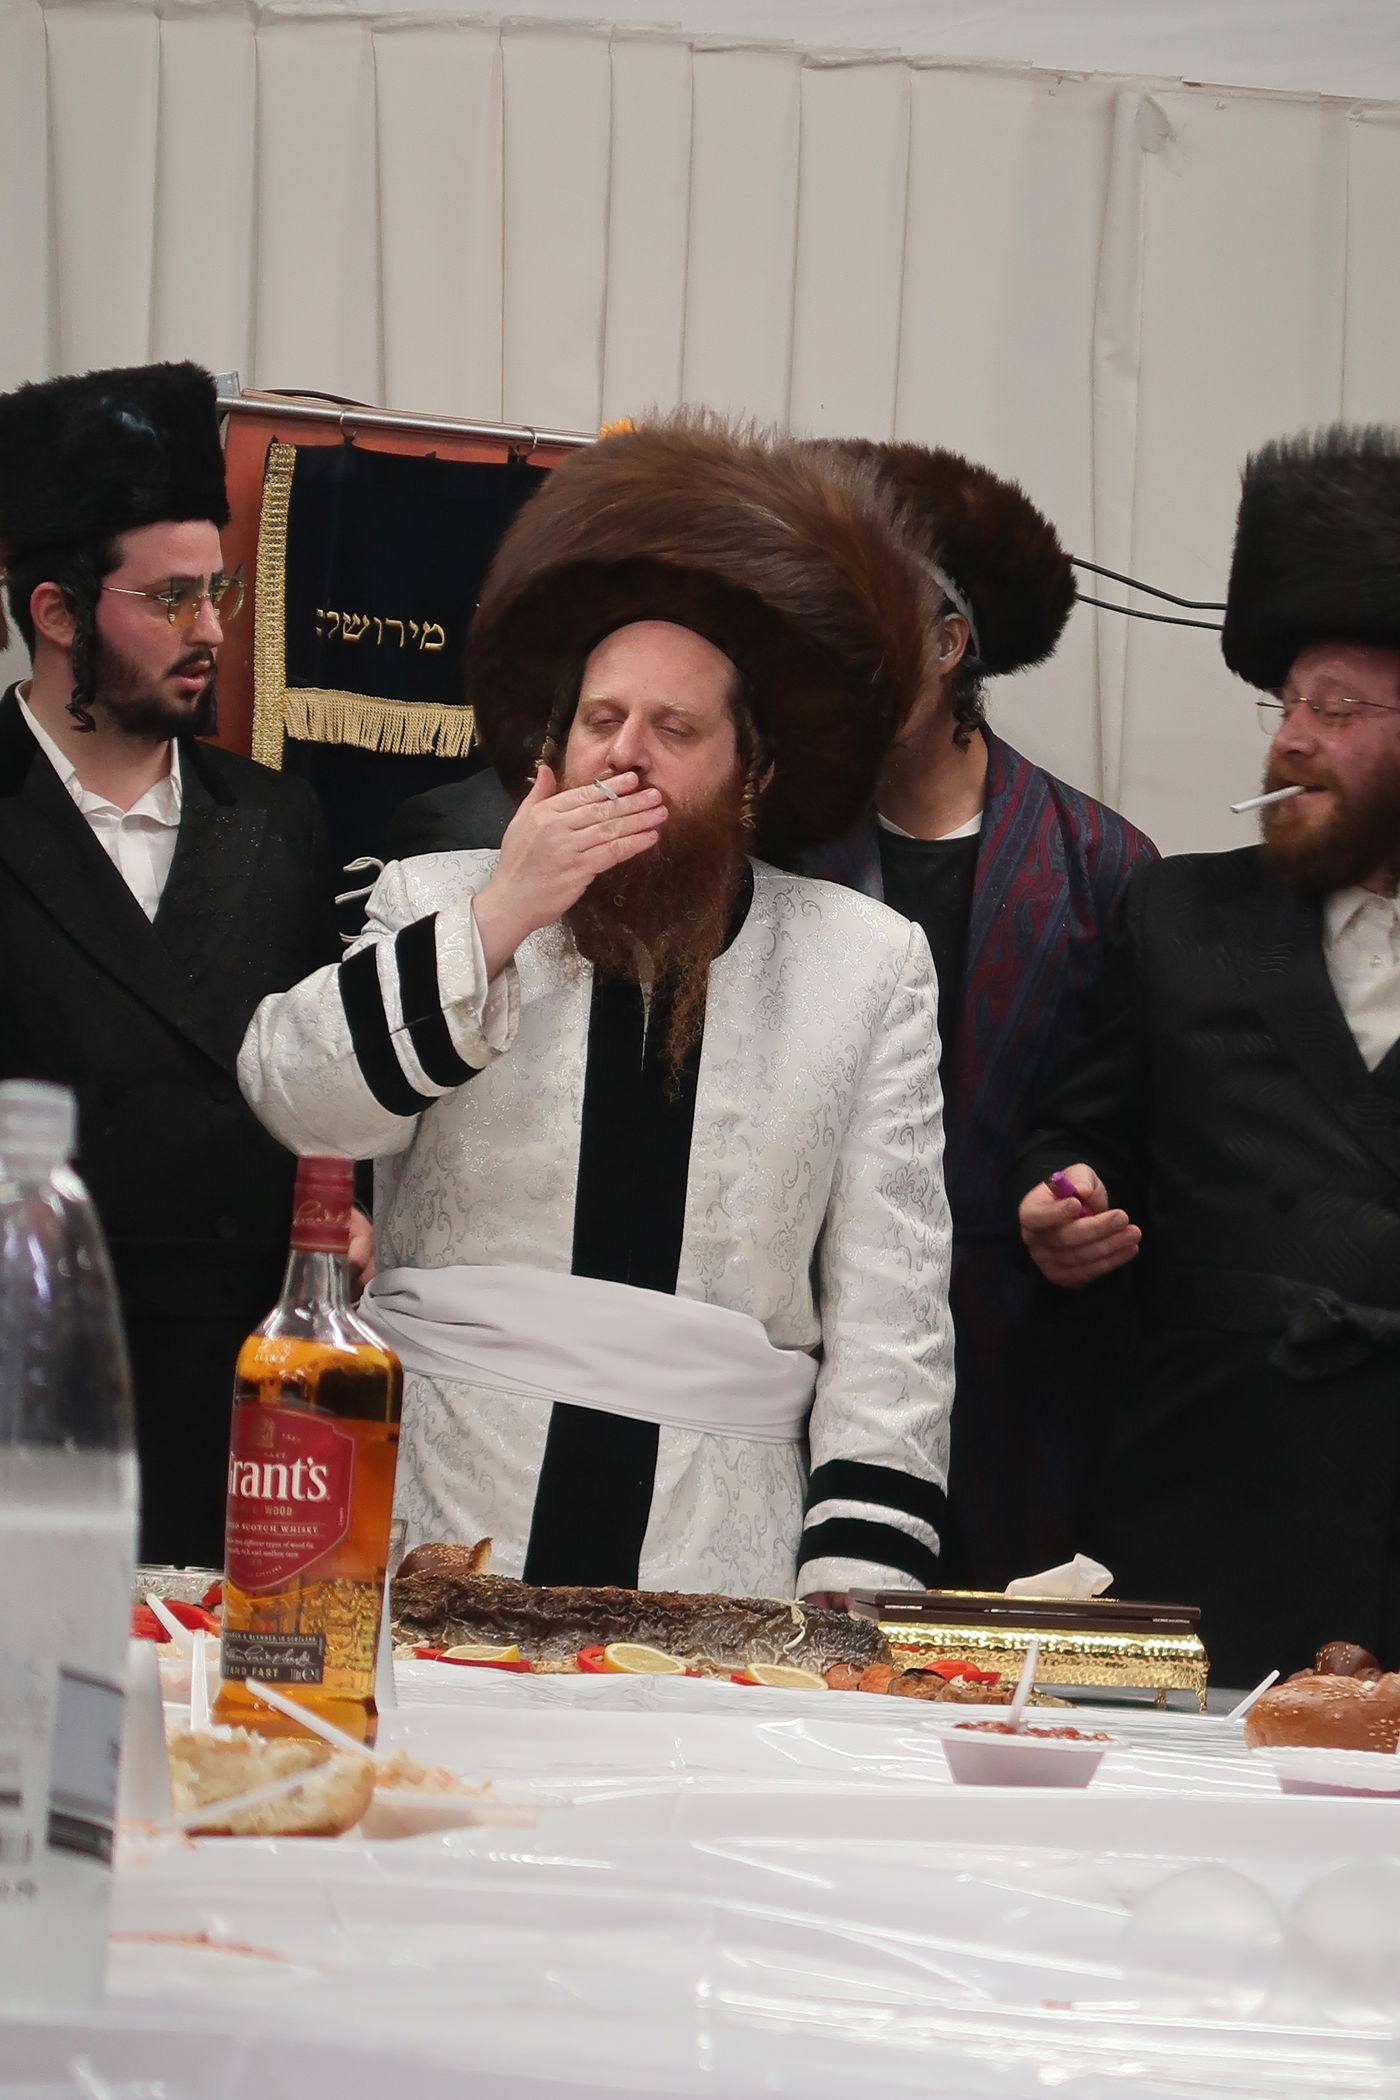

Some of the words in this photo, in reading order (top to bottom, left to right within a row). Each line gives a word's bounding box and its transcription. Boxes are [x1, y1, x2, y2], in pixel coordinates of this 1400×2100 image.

[227, 1450, 328, 1502] rant's
[264, 1505, 293, 1516] WOOD
[241, 1522, 277, 1533] SCOTCH
[280, 1524, 319, 1534] WHISKY
[252, 1666, 280, 1680] FAST
